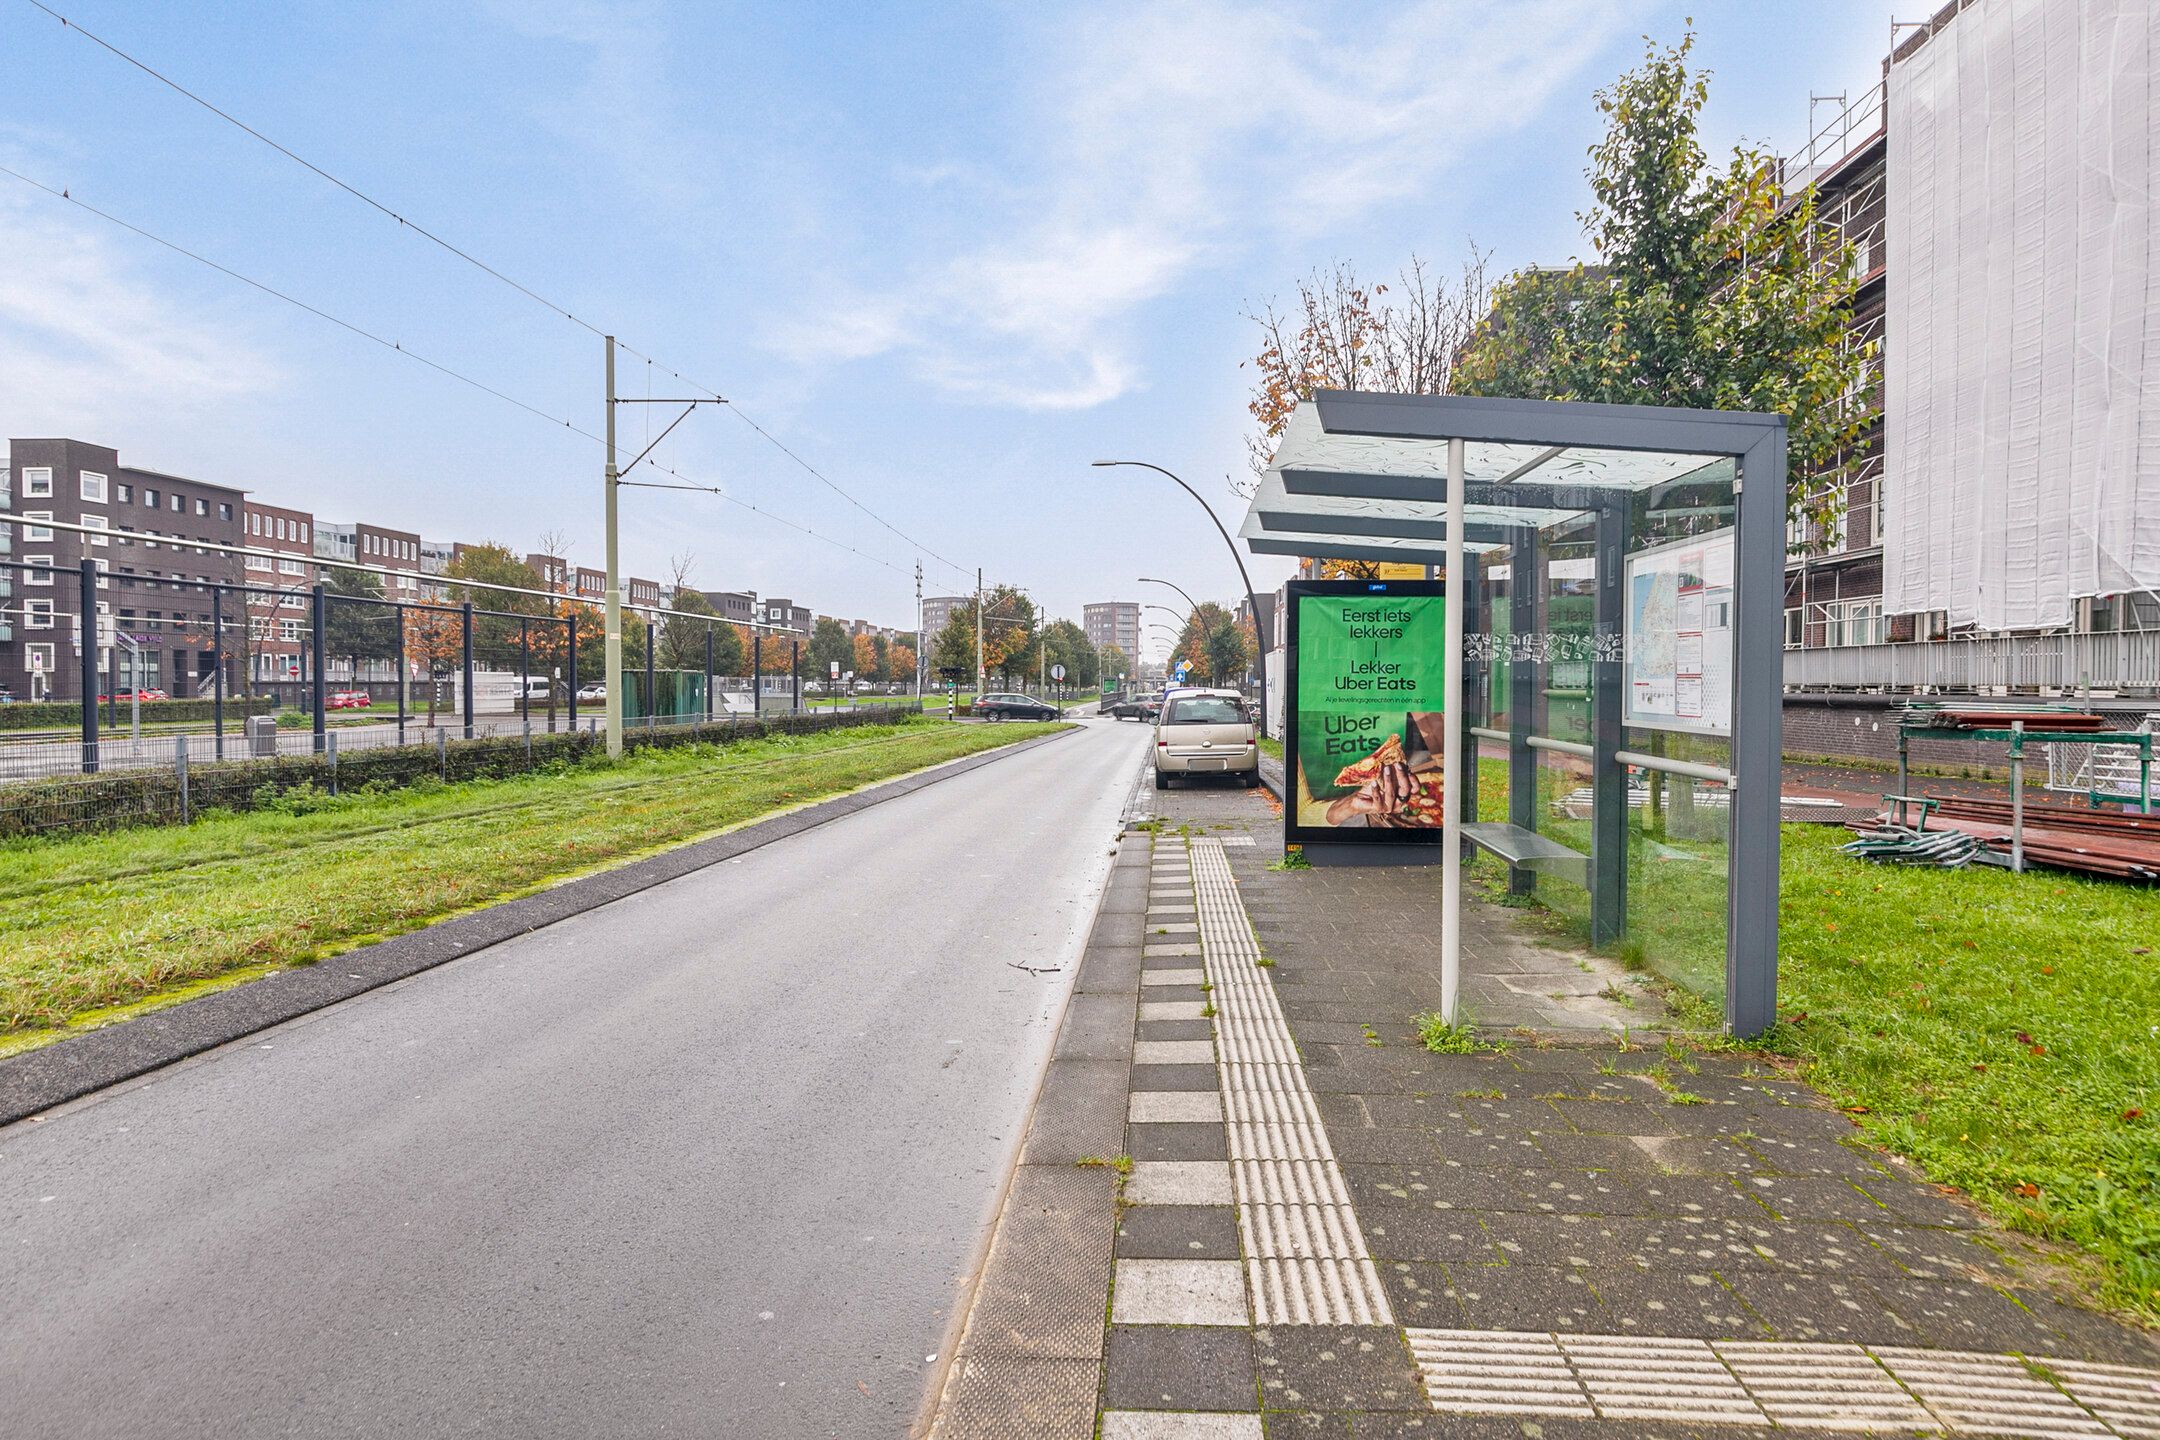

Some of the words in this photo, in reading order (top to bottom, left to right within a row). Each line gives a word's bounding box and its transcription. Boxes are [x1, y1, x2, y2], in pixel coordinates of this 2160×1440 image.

[1342, 608, 1381, 623] Eerst
[1383, 608, 1411, 623] iets
[1349, 624, 1403, 639] lekkers
[1350, 660, 1402, 674] Lekker
[1335, 676, 1374, 690] Uber
[1377, 677, 1416, 691] Eats
[1325, 714, 1381, 735] Uber
[1325, 735, 1382, 756] Eats
